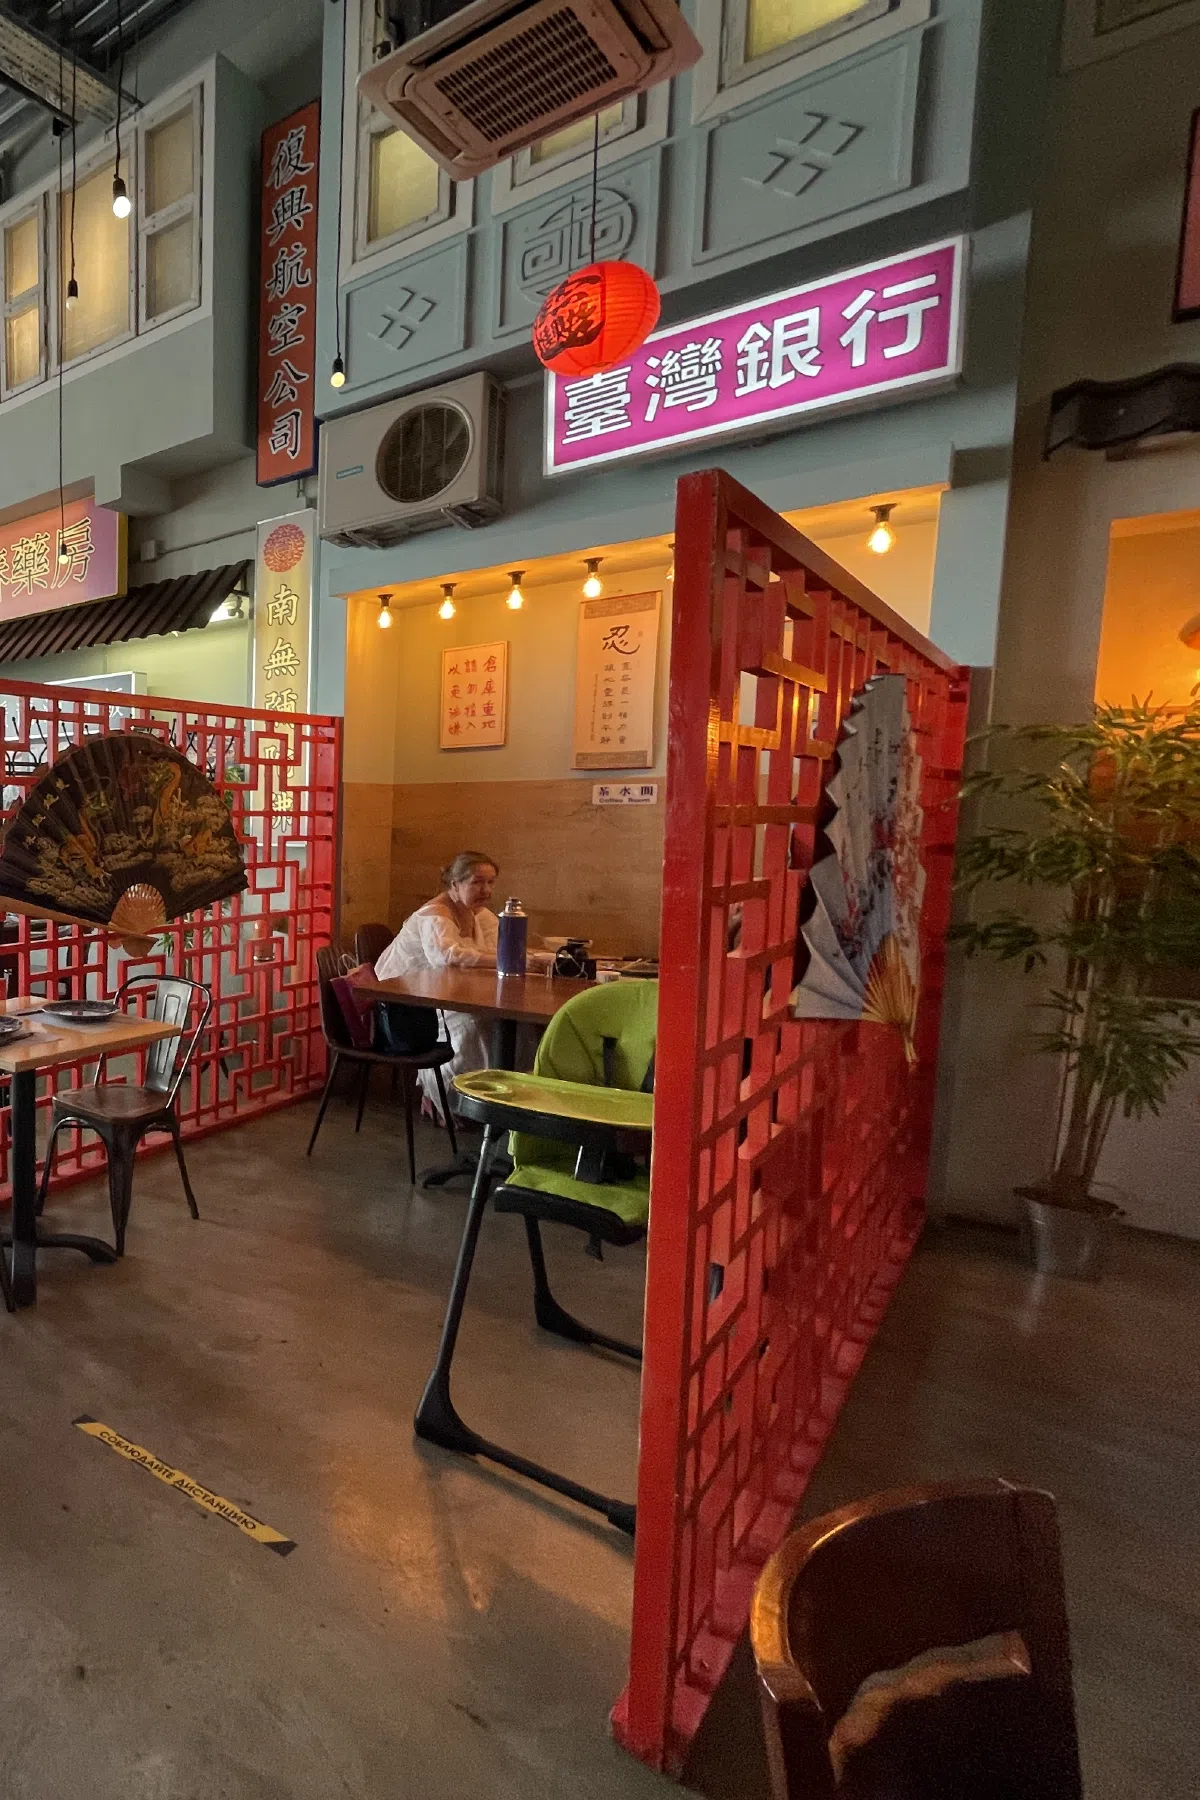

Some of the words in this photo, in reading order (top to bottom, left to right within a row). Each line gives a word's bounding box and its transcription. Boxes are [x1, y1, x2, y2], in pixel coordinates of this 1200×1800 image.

[264, 125, 314, 460] 復興航空公司
[561, 273, 940, 446] 臺灣銀行
[602, 624, 641, 655] 忍
[99, 1430, 175, 1480] СОБЛЮДАЙТЕ
[173, 1473, 257, 1531] ДИСТАНЦИЮ
